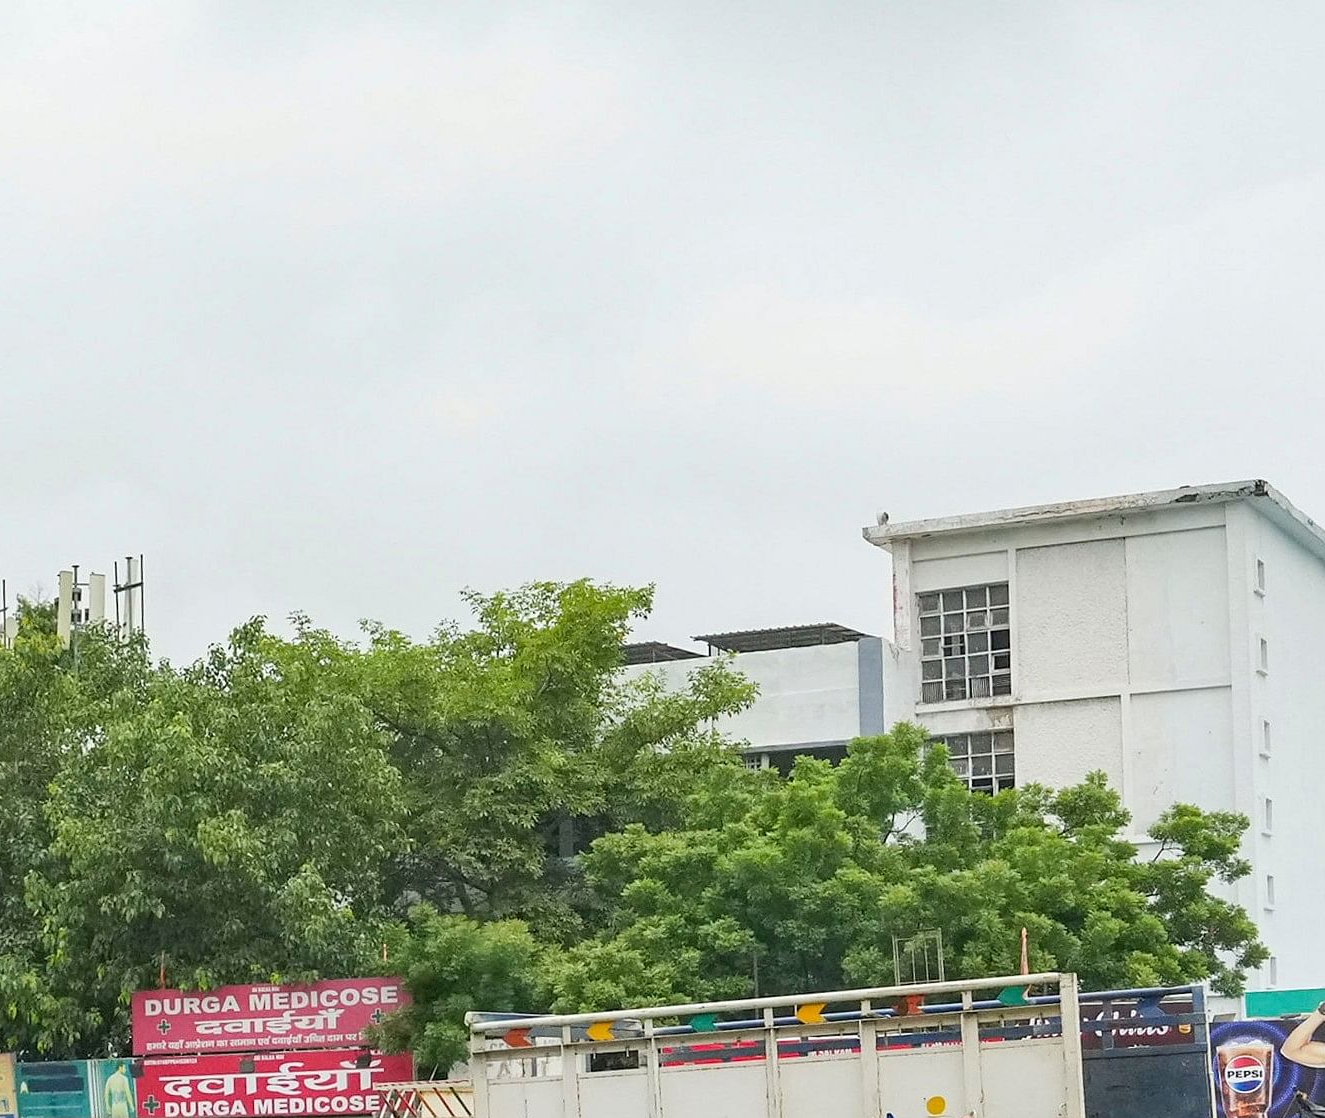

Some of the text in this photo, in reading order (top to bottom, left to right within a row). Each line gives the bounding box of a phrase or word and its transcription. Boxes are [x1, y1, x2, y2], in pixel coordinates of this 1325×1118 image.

[145, 985, 398, 1017] DURGA MEDICOSE
[1227, 1070, 1263, 1079] PEPSI
[164, 1094, 380, 1118] DURGA MEDICOSE
